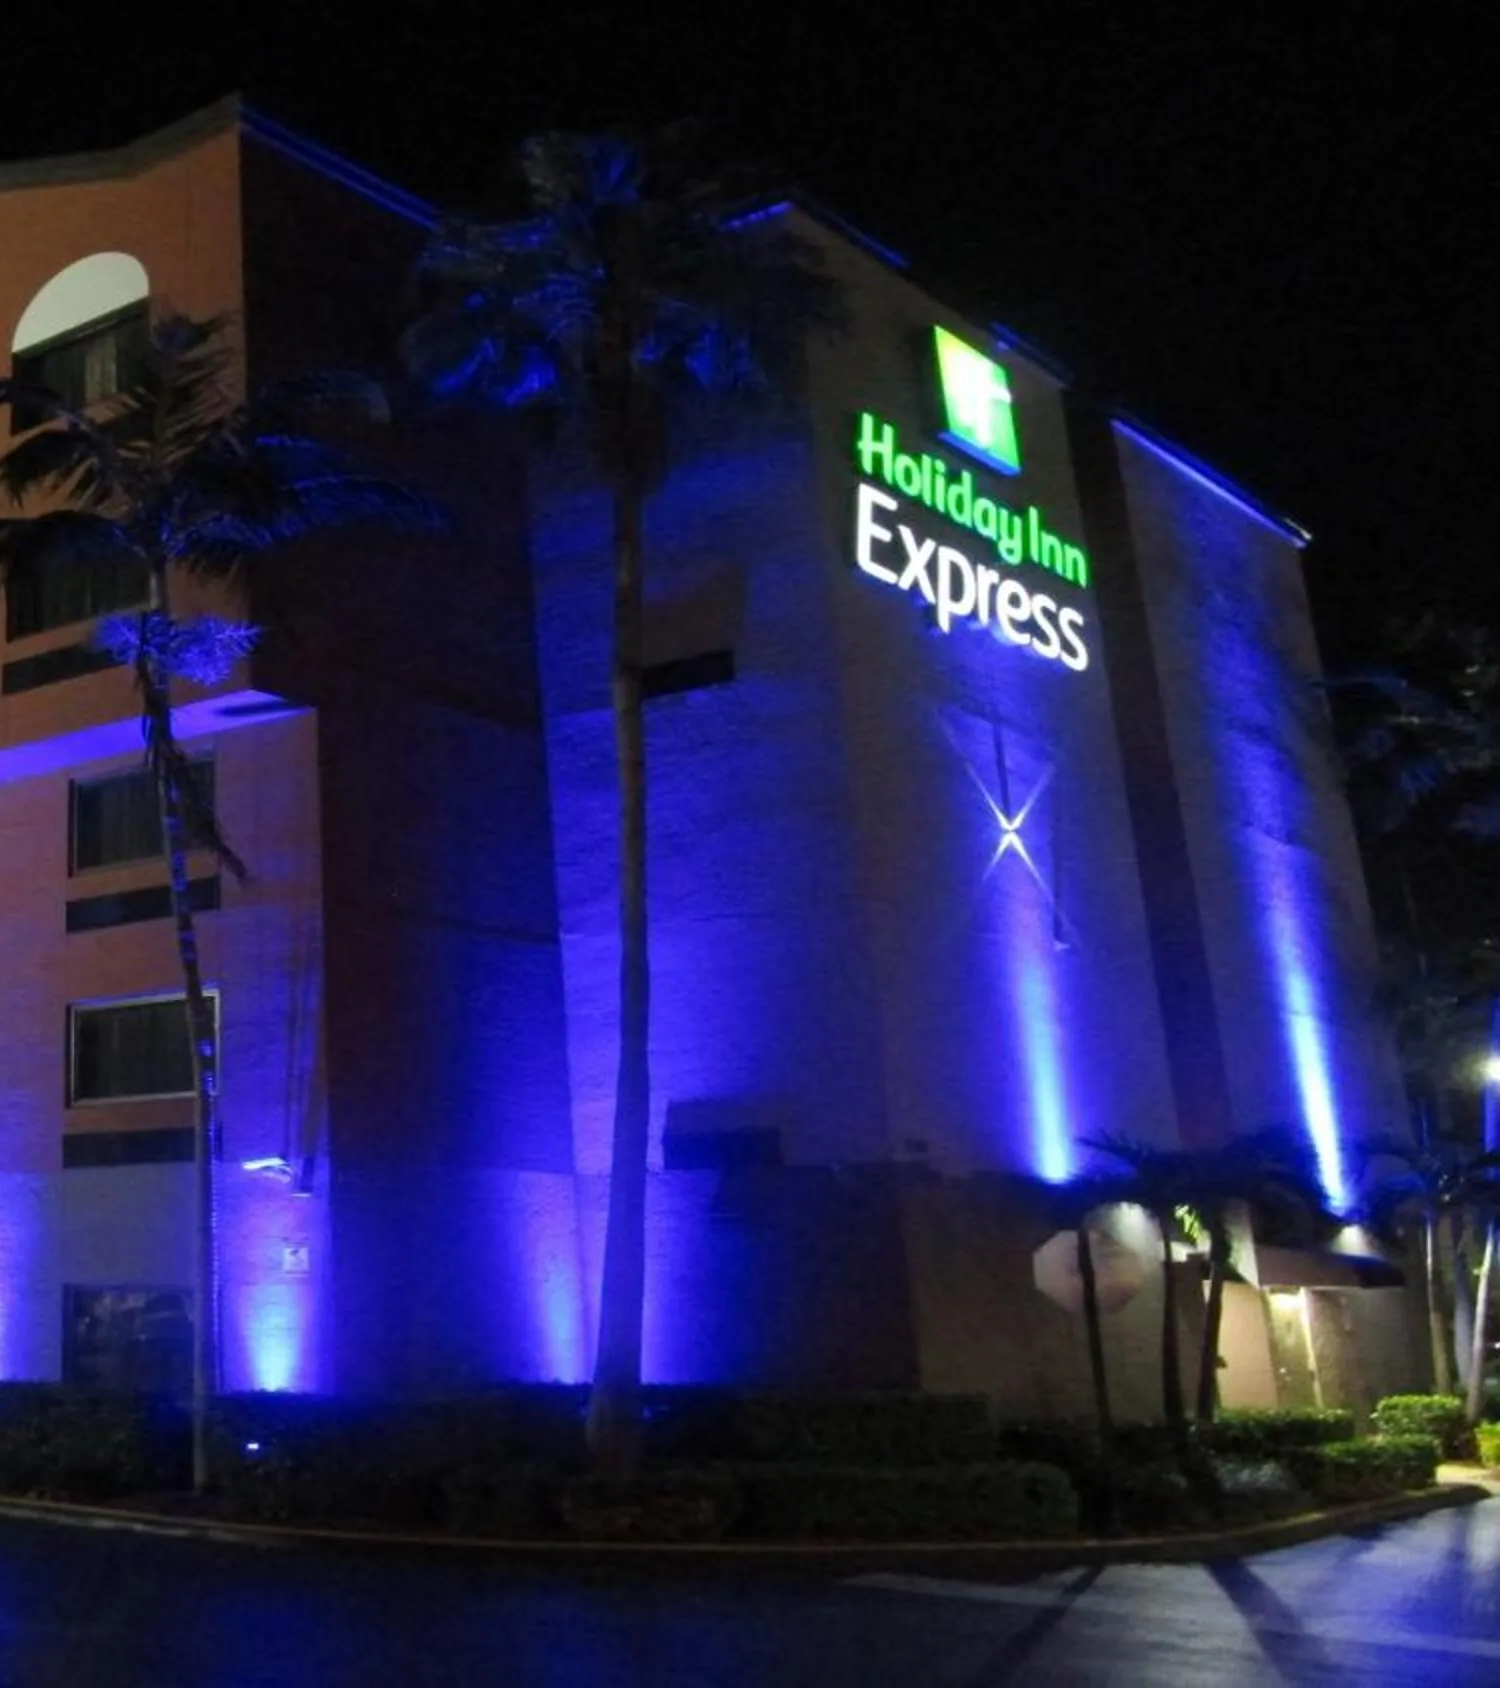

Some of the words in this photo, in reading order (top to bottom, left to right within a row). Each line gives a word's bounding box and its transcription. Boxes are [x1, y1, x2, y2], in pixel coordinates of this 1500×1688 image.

[856, 482, 1088, 672] Express
[858, 411, 1022, 566] Holiday
[1029, 505, 1087, 589] Inn
